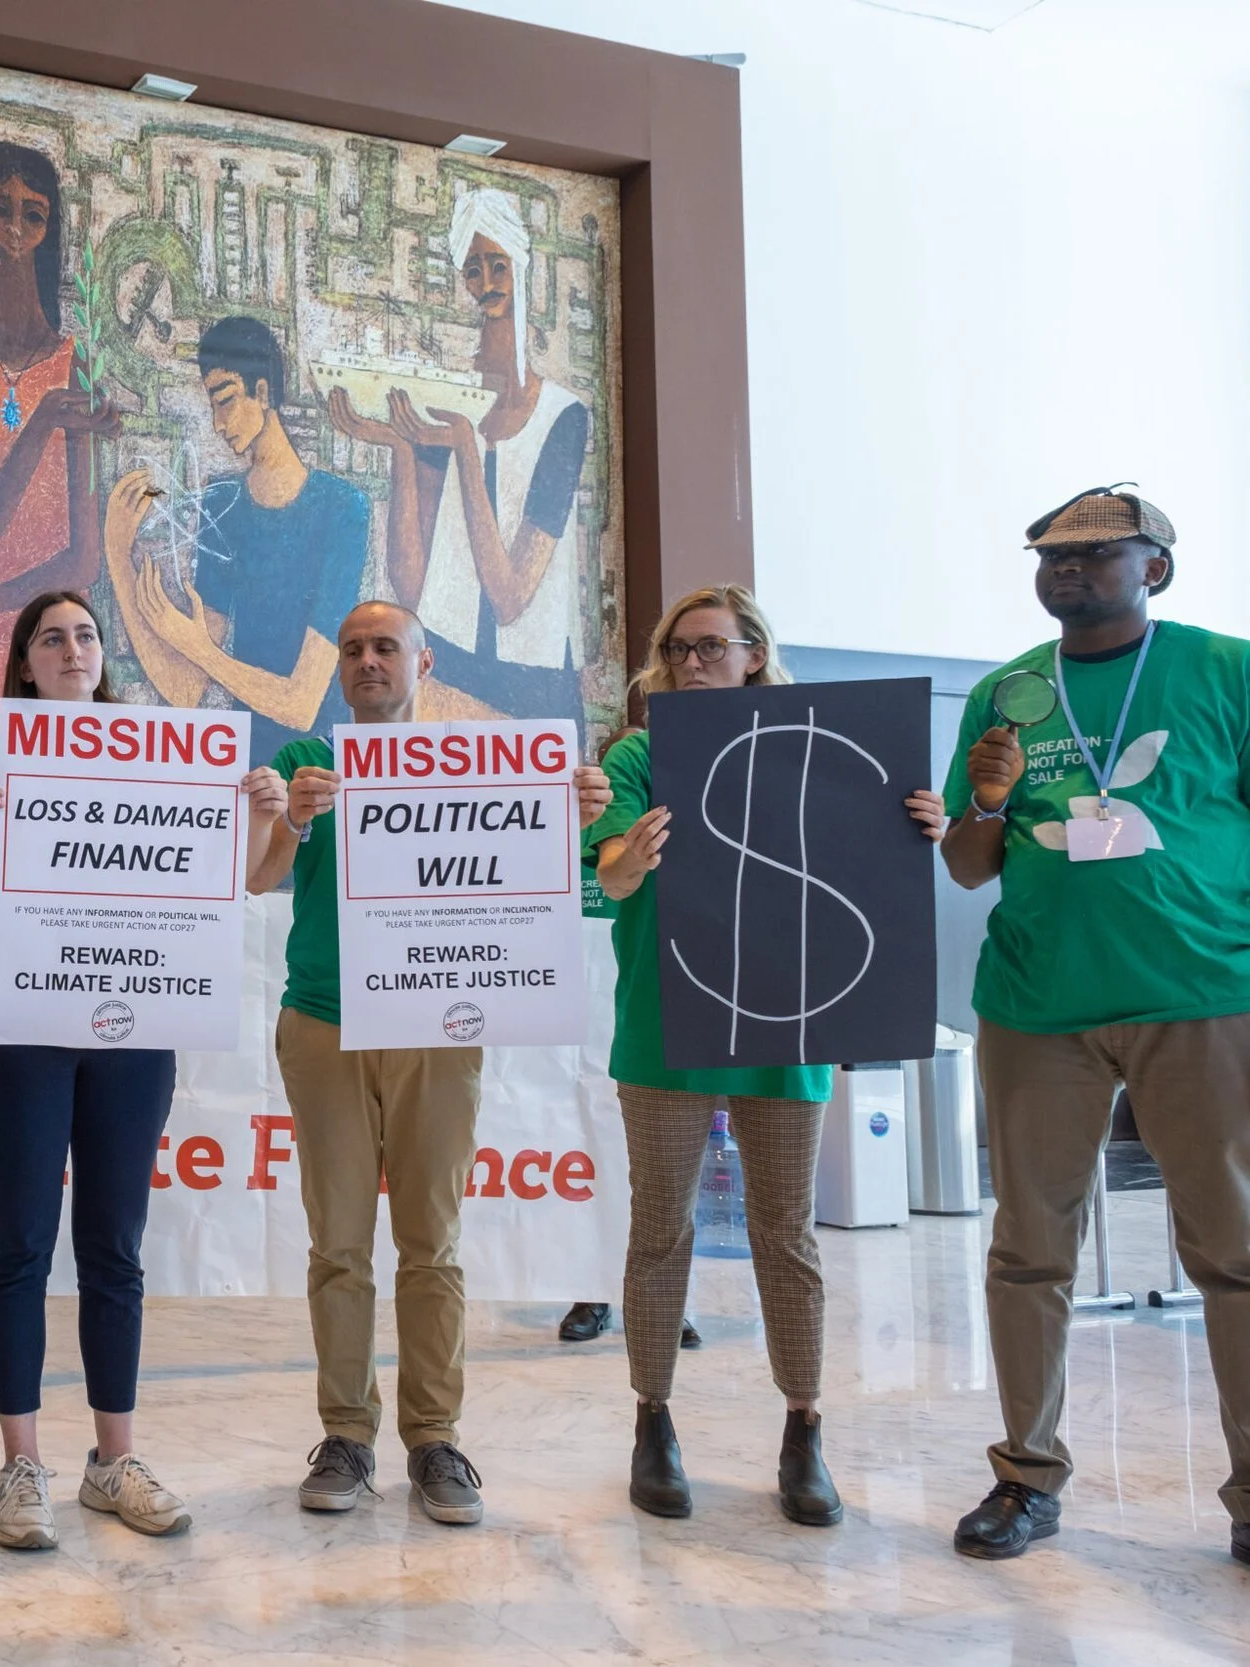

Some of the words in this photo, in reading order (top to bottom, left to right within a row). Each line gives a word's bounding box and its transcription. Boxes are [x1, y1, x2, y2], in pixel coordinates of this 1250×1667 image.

[7, 712, 236, 766] MISSING
[343, 732, 566, 778] MISSING
[1028, 755, 1057, 770] NOT
[1028, 769, 1064, 785] SALE
[14, 798, 78, 822] LOSS
[84, 801, 104, 824] &
[113, 803, 230, 829] DAMAGE
[359, 800, 546, 834] POLITICAL
[50, 841, 193, 873] FINANCE
[417, 855, 503, 887] WILL
[23, 906, 41, 914] YOU
[43, 907, 64, 915] HAVE
[84, 908, 143, 918] INFORMATION
[158, 911, 198, 920] POLITICAL
[365, 910, 372, 918] IF
[391, 909, 412, 917] HAVE
[431, 907, 487, 916] INFORMATION
[489, 906, 500, 914] OR
[582, 899, 603, 908] SALE
[40, 918, 68, 927] PLEASE
[70, 919, 90, 928] TAKE
[92, 920, 125, 929] URGENT
[126, 922, 157, 930] ACTION
[169, 923, 196, 932] COP27
[385, 920, 412, 928] PLEASE
[414, 919, 433, 927] TAKE
[434, 918, 466, 927] URGENT
[467, 918, 496, 926] ACTION
[498, 917, 508, 925] AT
[509, 916, 534, 925] COP27
[60, 946, 165, 967] REWARD:
[407, 944, 507, 963] REWARD:
[14, 972, 112, 992] CLIMATE
[119, 975, 212, 995] JUSTICE
[366, 972, 459, 991] CLIMATE
[465, 969, 556, 988] JUSTICE
